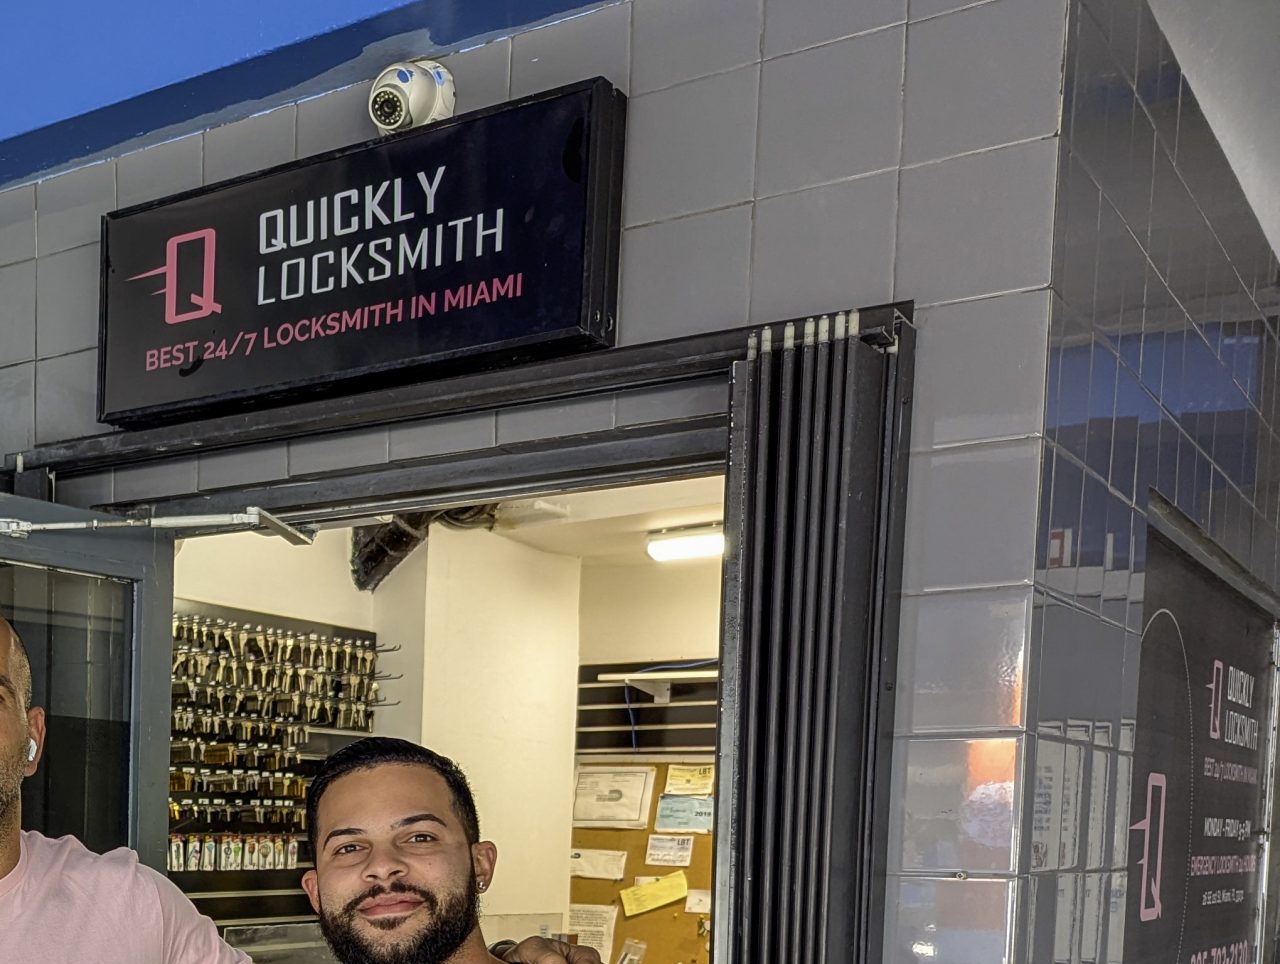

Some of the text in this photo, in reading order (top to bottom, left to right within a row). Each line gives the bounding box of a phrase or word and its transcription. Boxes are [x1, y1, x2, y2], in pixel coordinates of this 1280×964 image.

[259, 166, 446, 255] QUICKLY
[257, 208, 504, 305] LOCKSMITH
[145, 273, 523, 372] BEST 24/7 LOCKSMITH IN MIAMI
[1224, 709, 1258, 751] LOCKSMITH
[1227, 665, 1255, 709] QUICKLY
